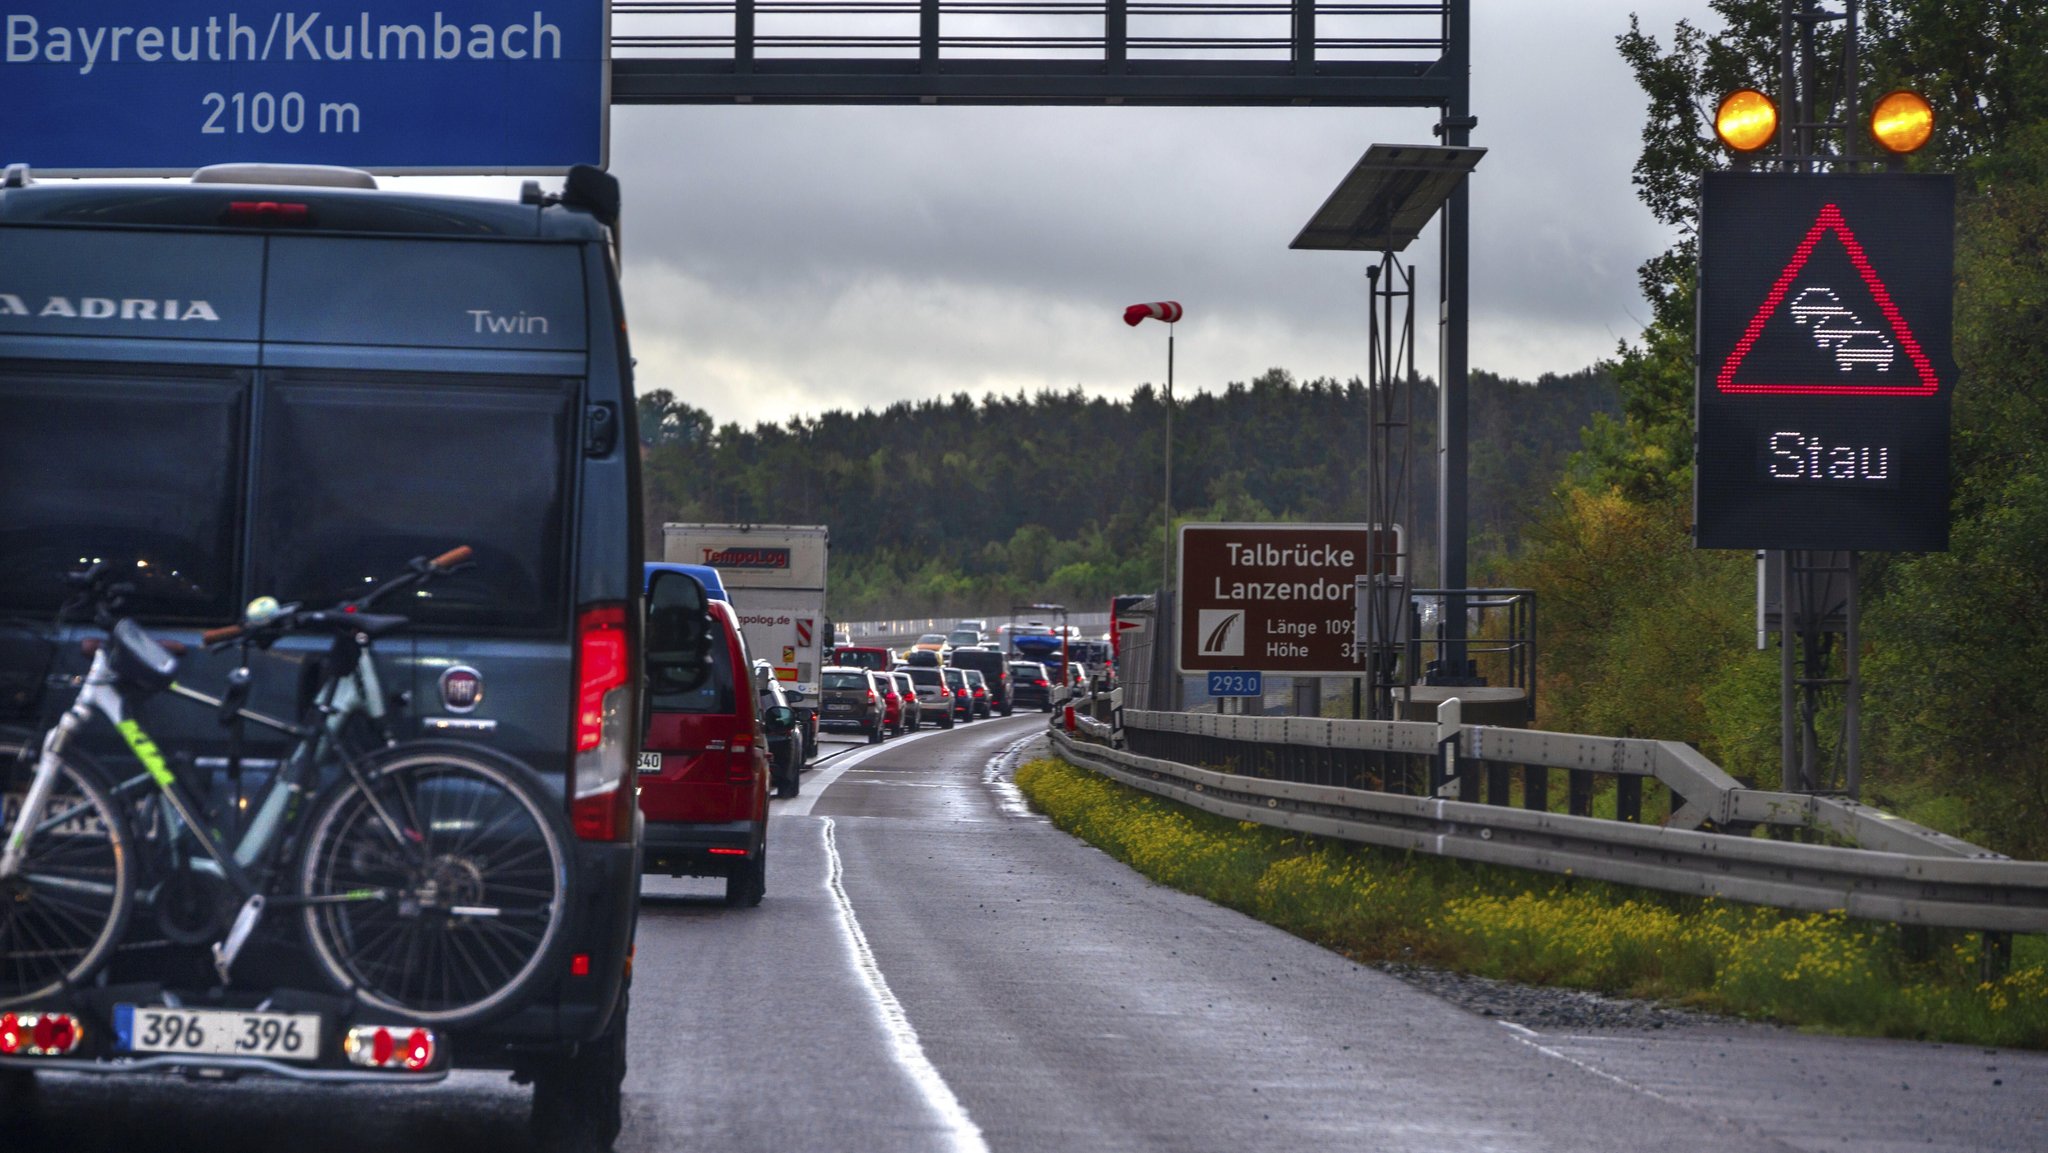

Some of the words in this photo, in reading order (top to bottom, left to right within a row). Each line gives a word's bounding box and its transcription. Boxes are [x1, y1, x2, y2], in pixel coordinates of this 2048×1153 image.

[5, 12, 562, 74] Bayreuth/Kulmbach
[201, 92, 305, 134] 2100
[319, 101, 360, 132] m
[38, 296, 220, 321] ADRIA
[466, 310, 549, 334] Twin
[1769, 431, 1888, 479] Stau
[703, 548, 786, 568] TempoLog
[1226, 543, 1355, 567] Talbrücke
[1215, 577, 1354, 600] Lanzendor
[1267, 619, 1317, 637] Länge
[1266, 642, 1309, 657] Höhe
[1212, 676, 1257, 692] 293.0
[143, 1014, 204, 1047] 396
[241, 1018, 302, 1052] 396
